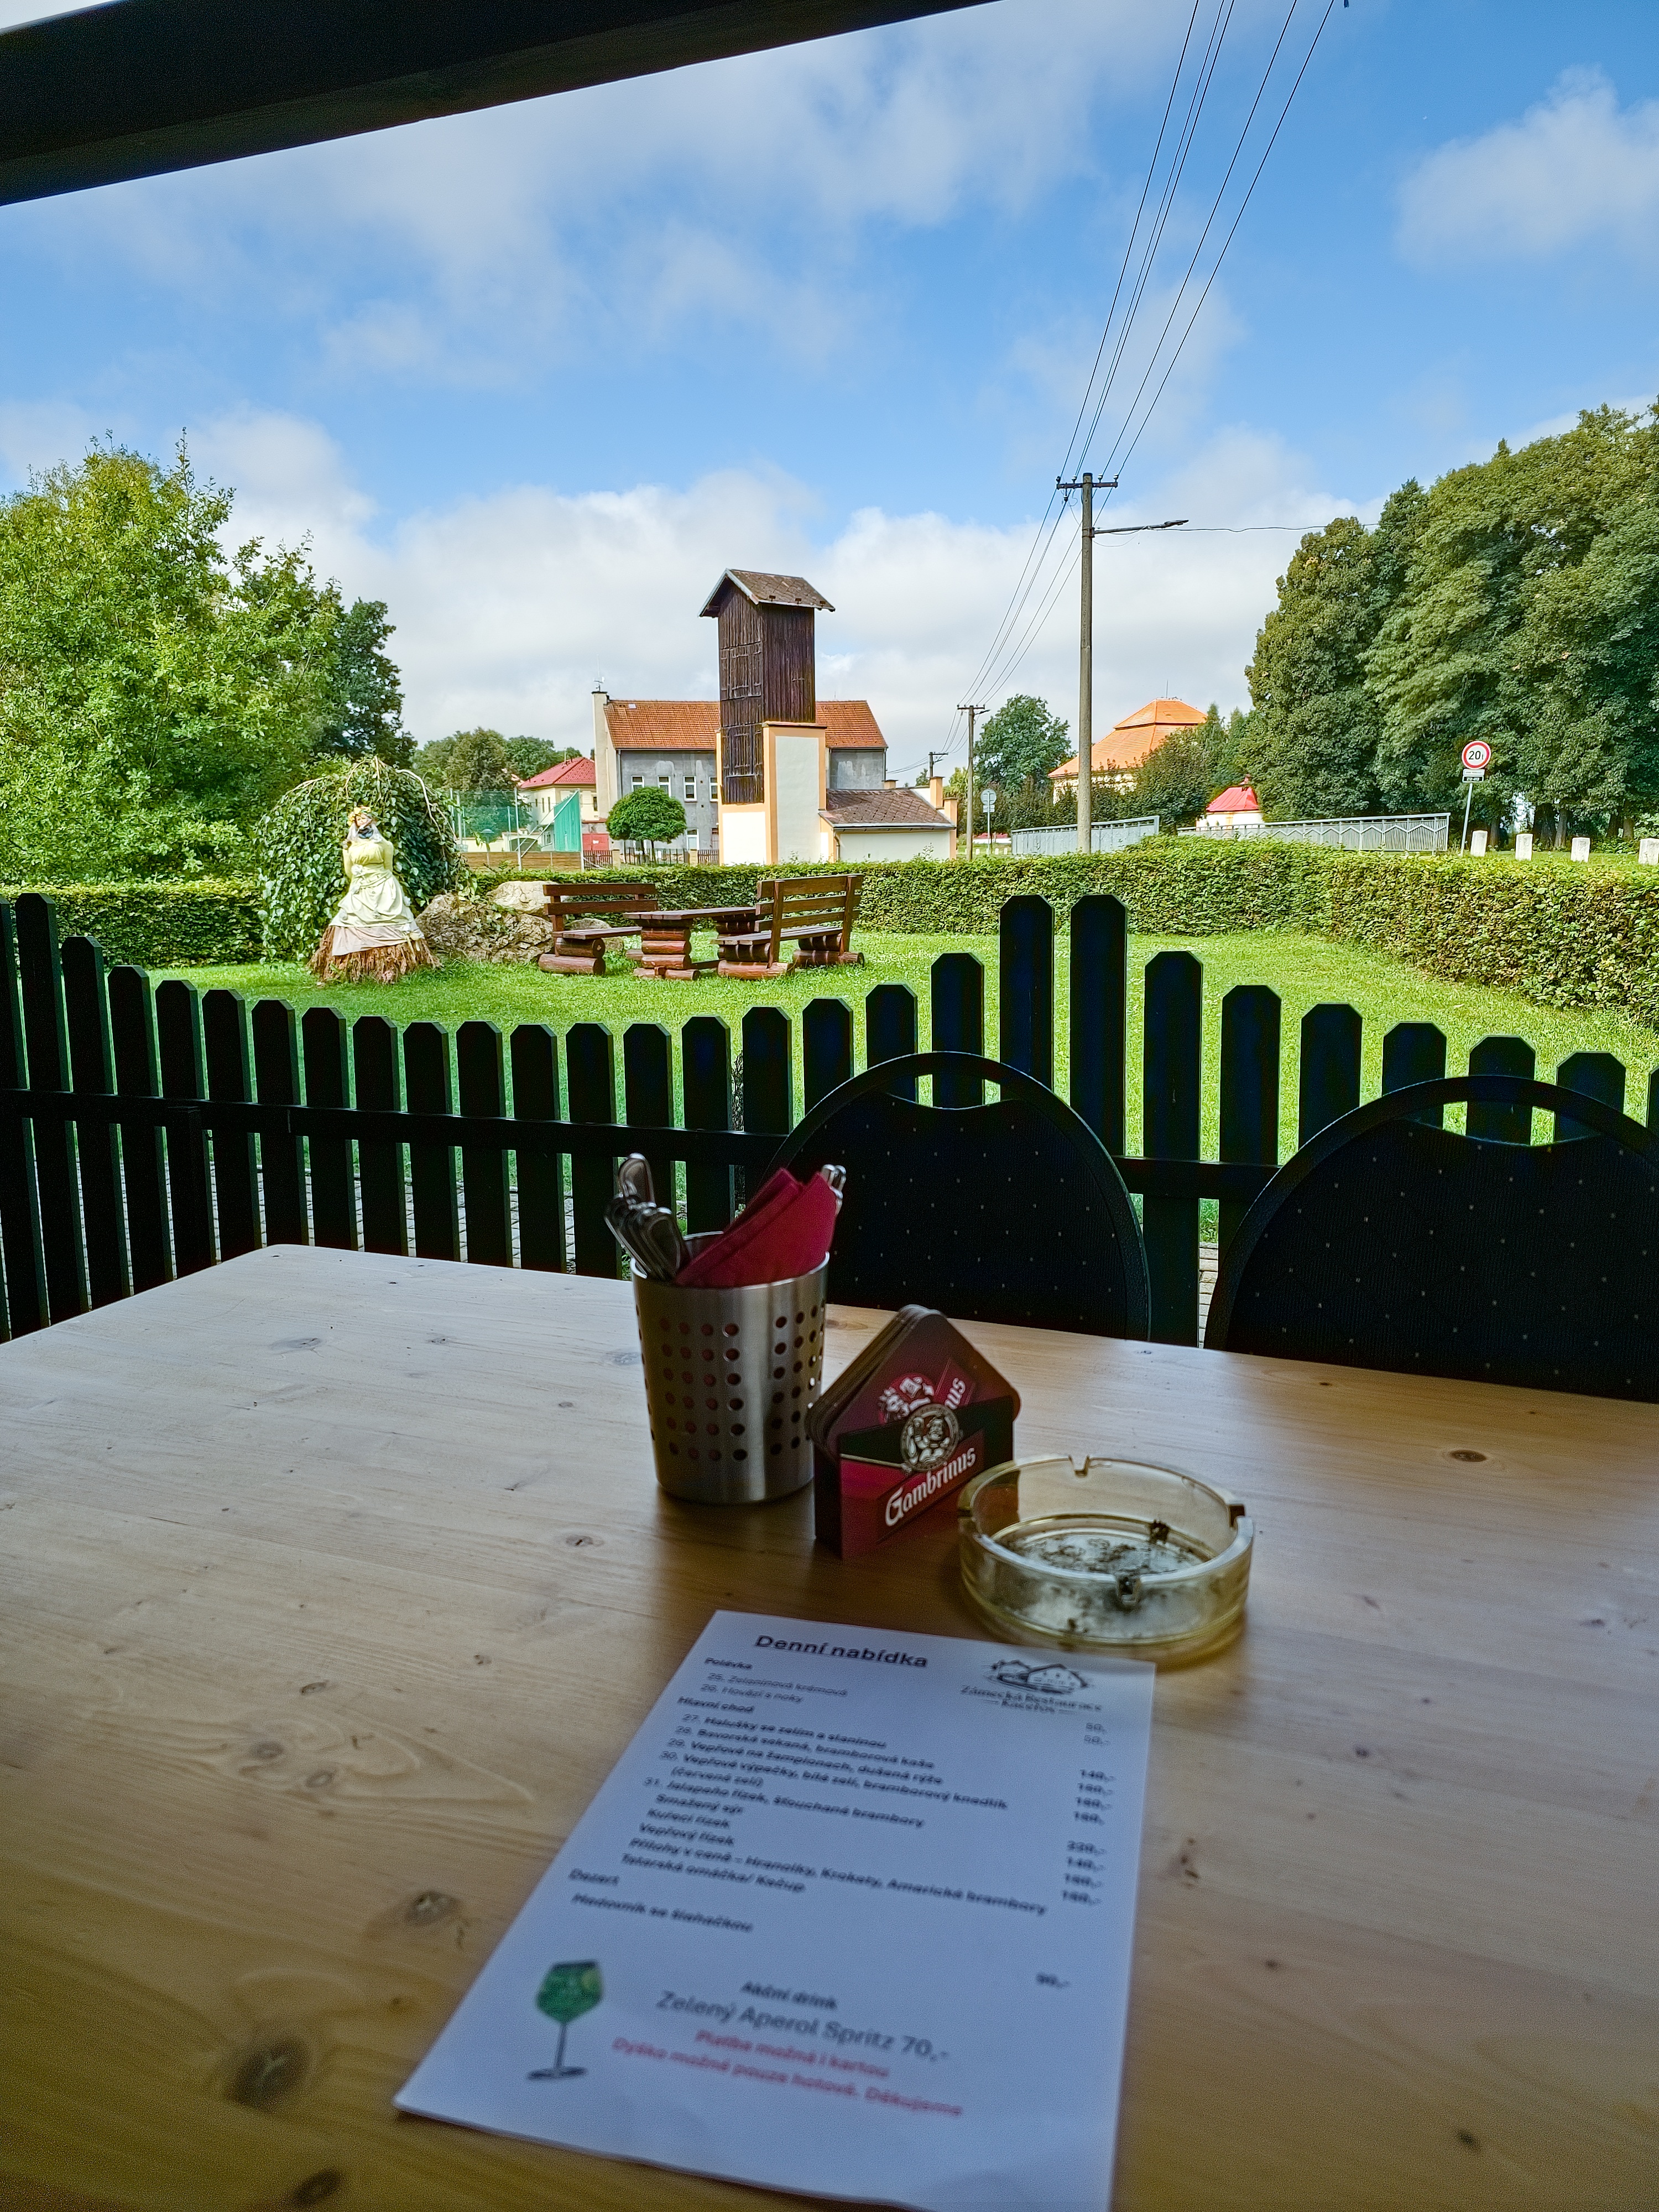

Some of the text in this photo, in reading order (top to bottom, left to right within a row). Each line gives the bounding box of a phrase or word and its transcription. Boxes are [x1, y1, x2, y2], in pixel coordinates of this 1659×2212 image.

[885, 1447, 976, 1526] Gambrinus
[704, 1657, 752, 1670] Polévka
[754, 1635, 928, 1668] Denní nabídka
[677, 1696, 755, 1714] Hlavní chod
[721, 1686, 762, 1698] Hovězí
[774, 1693, 803, 1704] noky
[795, 1683, 847, 1697] krémová
[697, 1728, 758, 1743] Bavorská
[815, 1744, 898, 1764] bramborová
[901, 1757, 935, 1769] kaše
[704, 1716, 758, 1731] Halušky
[760, 1724, 775, 1733] se
[778, 1726, 814, 1738] zelím
[816, 1731, 825, 1740] a
[828, 1734, 887, 1749] slaninou
[691, 1740, 745, 1756] Vepřové
[746, 1749, 764, 1758] na
[857, 1765, 910, 1780] dušená
[912, 1773, 943, 1786] rýže
[684, 1753, 737, 1769] Vepřové
[863, 1779, 951, 1803] bramborový
[953, 1793, 1008, 1810] knedlík
[646, 1808, 730, 1829] Kuřecí řízek
[656, 1793, 744, 1815] Smažený sýr
[666, 1780, 729, 1797] Jalapeño
[852, 1807, 925, 1829] brambory
[639, 1822, 734, 1846] Vepřový řízek
[568, 1868, 619, 1887] Dezert
[620, 1853, 684, 1872] Tatarská
[755, 1874, 806, 1893] Kečup
[629, 1837, 682, 1855] Přílohy
[683, 1848, 692, 1856] v
[694, 1849, 732, 1863] ceně
[886, 1878, 963, 1899] Americké
[966, 1890, 1047, 1917] brambory
[792, 1991, 838, 2011] drink
[655, 1990, 737, 2024] Zelený
[738, 2005, 820, 2035] Aperol
[821, 2020, 895, 2051] Spritz
[670, 2051, 730, 2073] možná
[731, 2063, 789, 2084] pouze
[695, 2029, 753, 2053] Platba
[754, 2042, 817, 2065] možná
[828, 2052, 890, 2078] kartou
